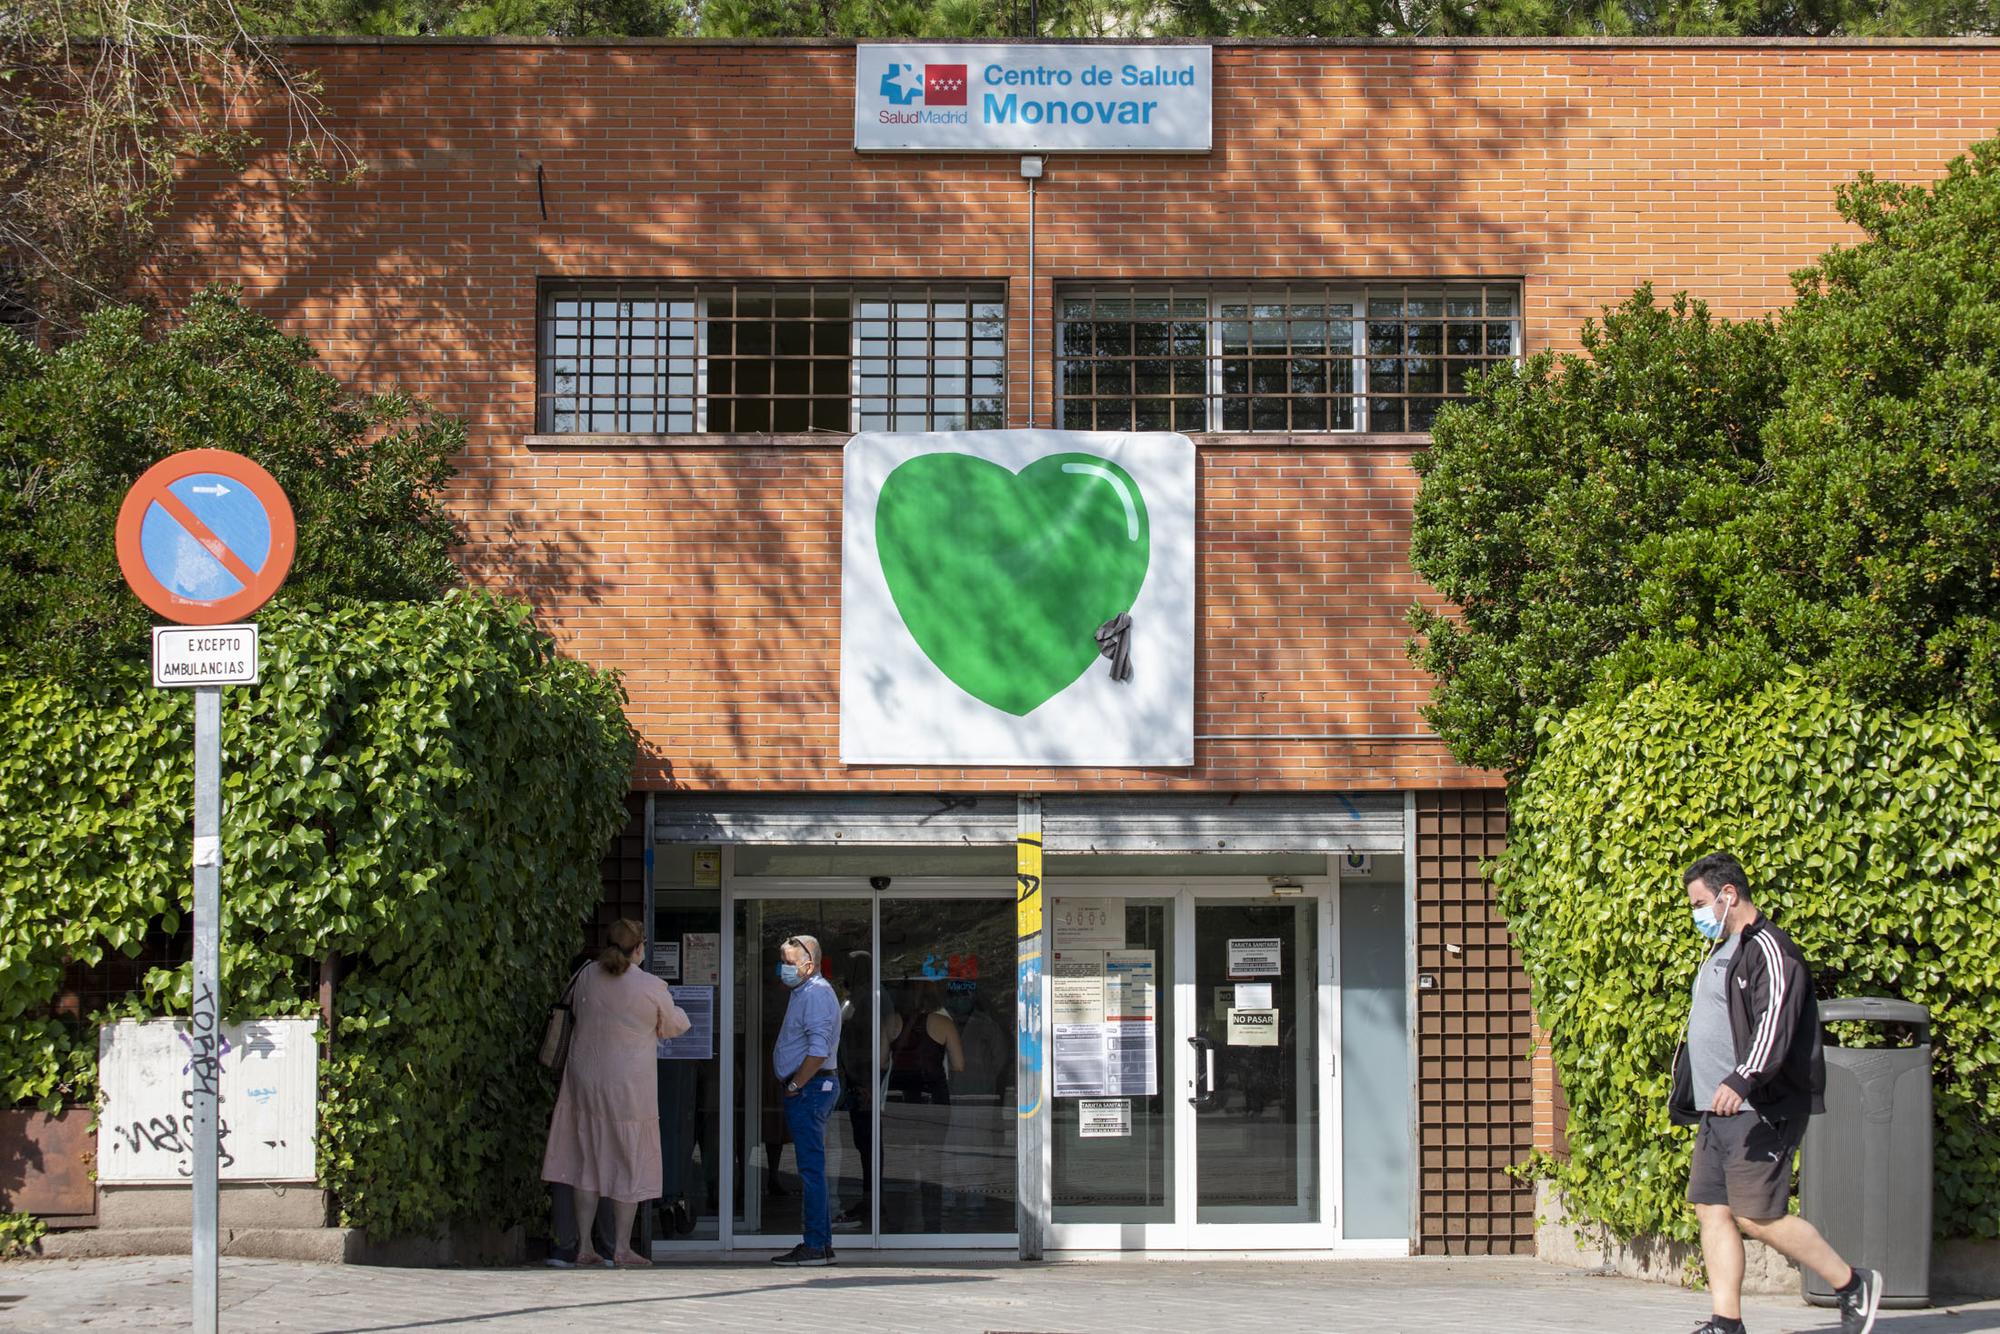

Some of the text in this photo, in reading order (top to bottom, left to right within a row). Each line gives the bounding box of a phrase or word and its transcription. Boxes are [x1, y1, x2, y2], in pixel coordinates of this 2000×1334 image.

[984, 64, 1194, 86] Centro de Salud
[983, 93, 1157, 125] Monovar
[879, 110, 968, 125] SaludMadrid
[188, 638, 241, 651] EXCEPTO
[163, 661, 245, 676] AMBULANCIAS
[1233, 1015, 1273, 1023] NO PASAR
